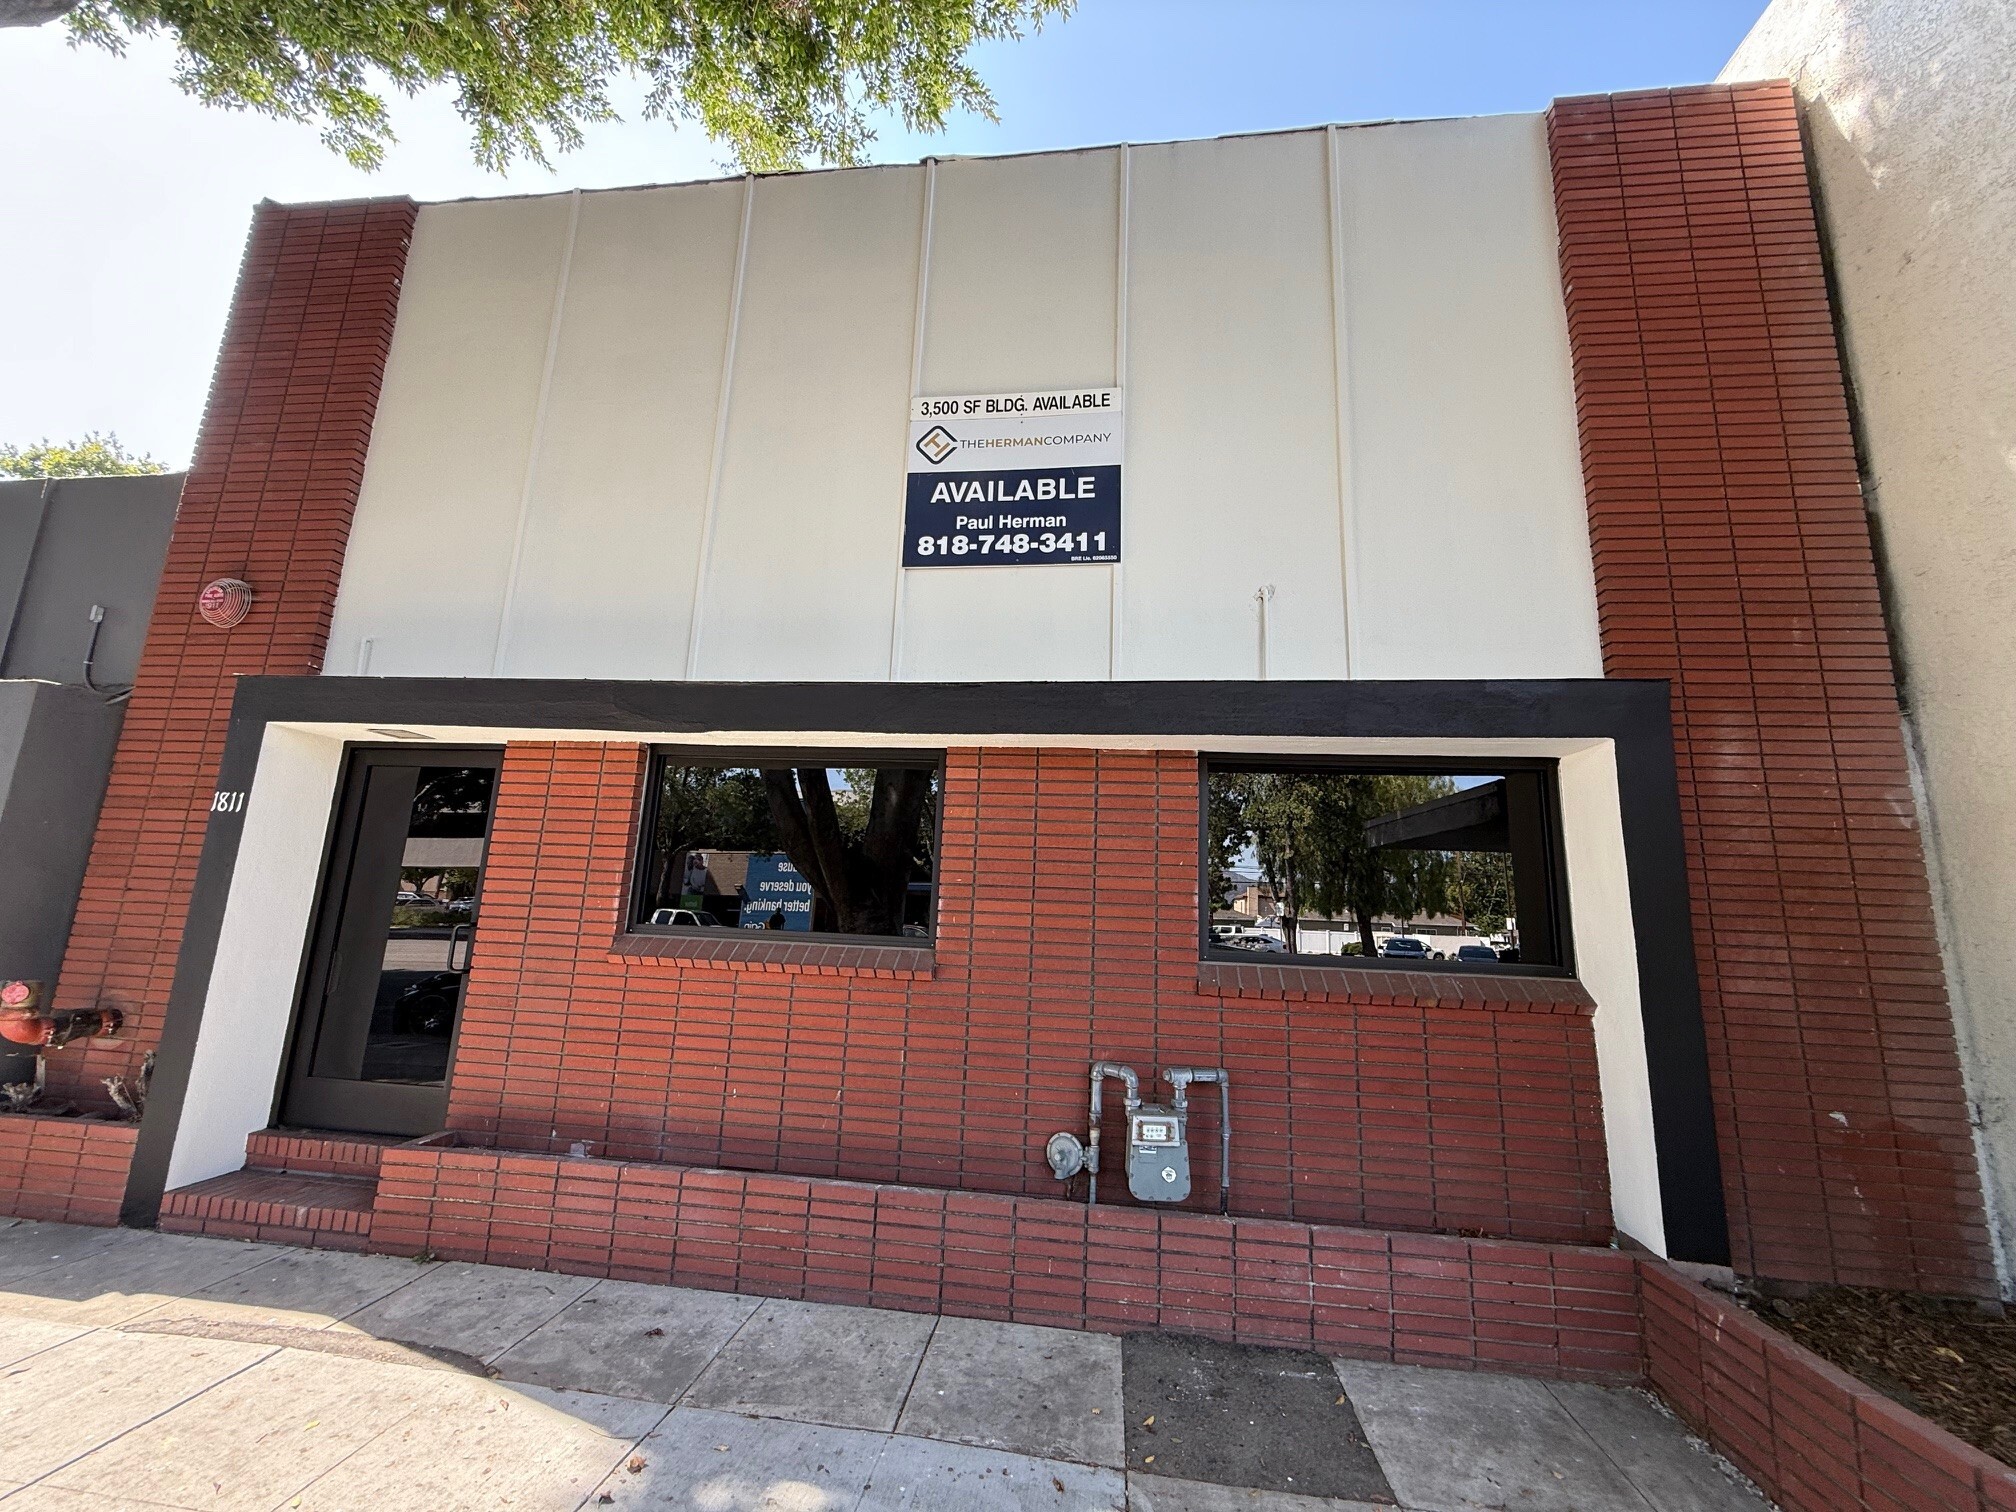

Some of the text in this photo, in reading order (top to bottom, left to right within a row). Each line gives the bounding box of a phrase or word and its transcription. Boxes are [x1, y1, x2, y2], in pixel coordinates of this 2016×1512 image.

[921, 392, 1111, 418] 3,500 SF BLDG. AVAILABLE
[930, 476, 1096, 504] AVAILABLE
[956, 515, 1066, 530] Paul Herman
[917, 531, 1106, 557] 818-748-3411
[210, 791, 245, 813] 1811
